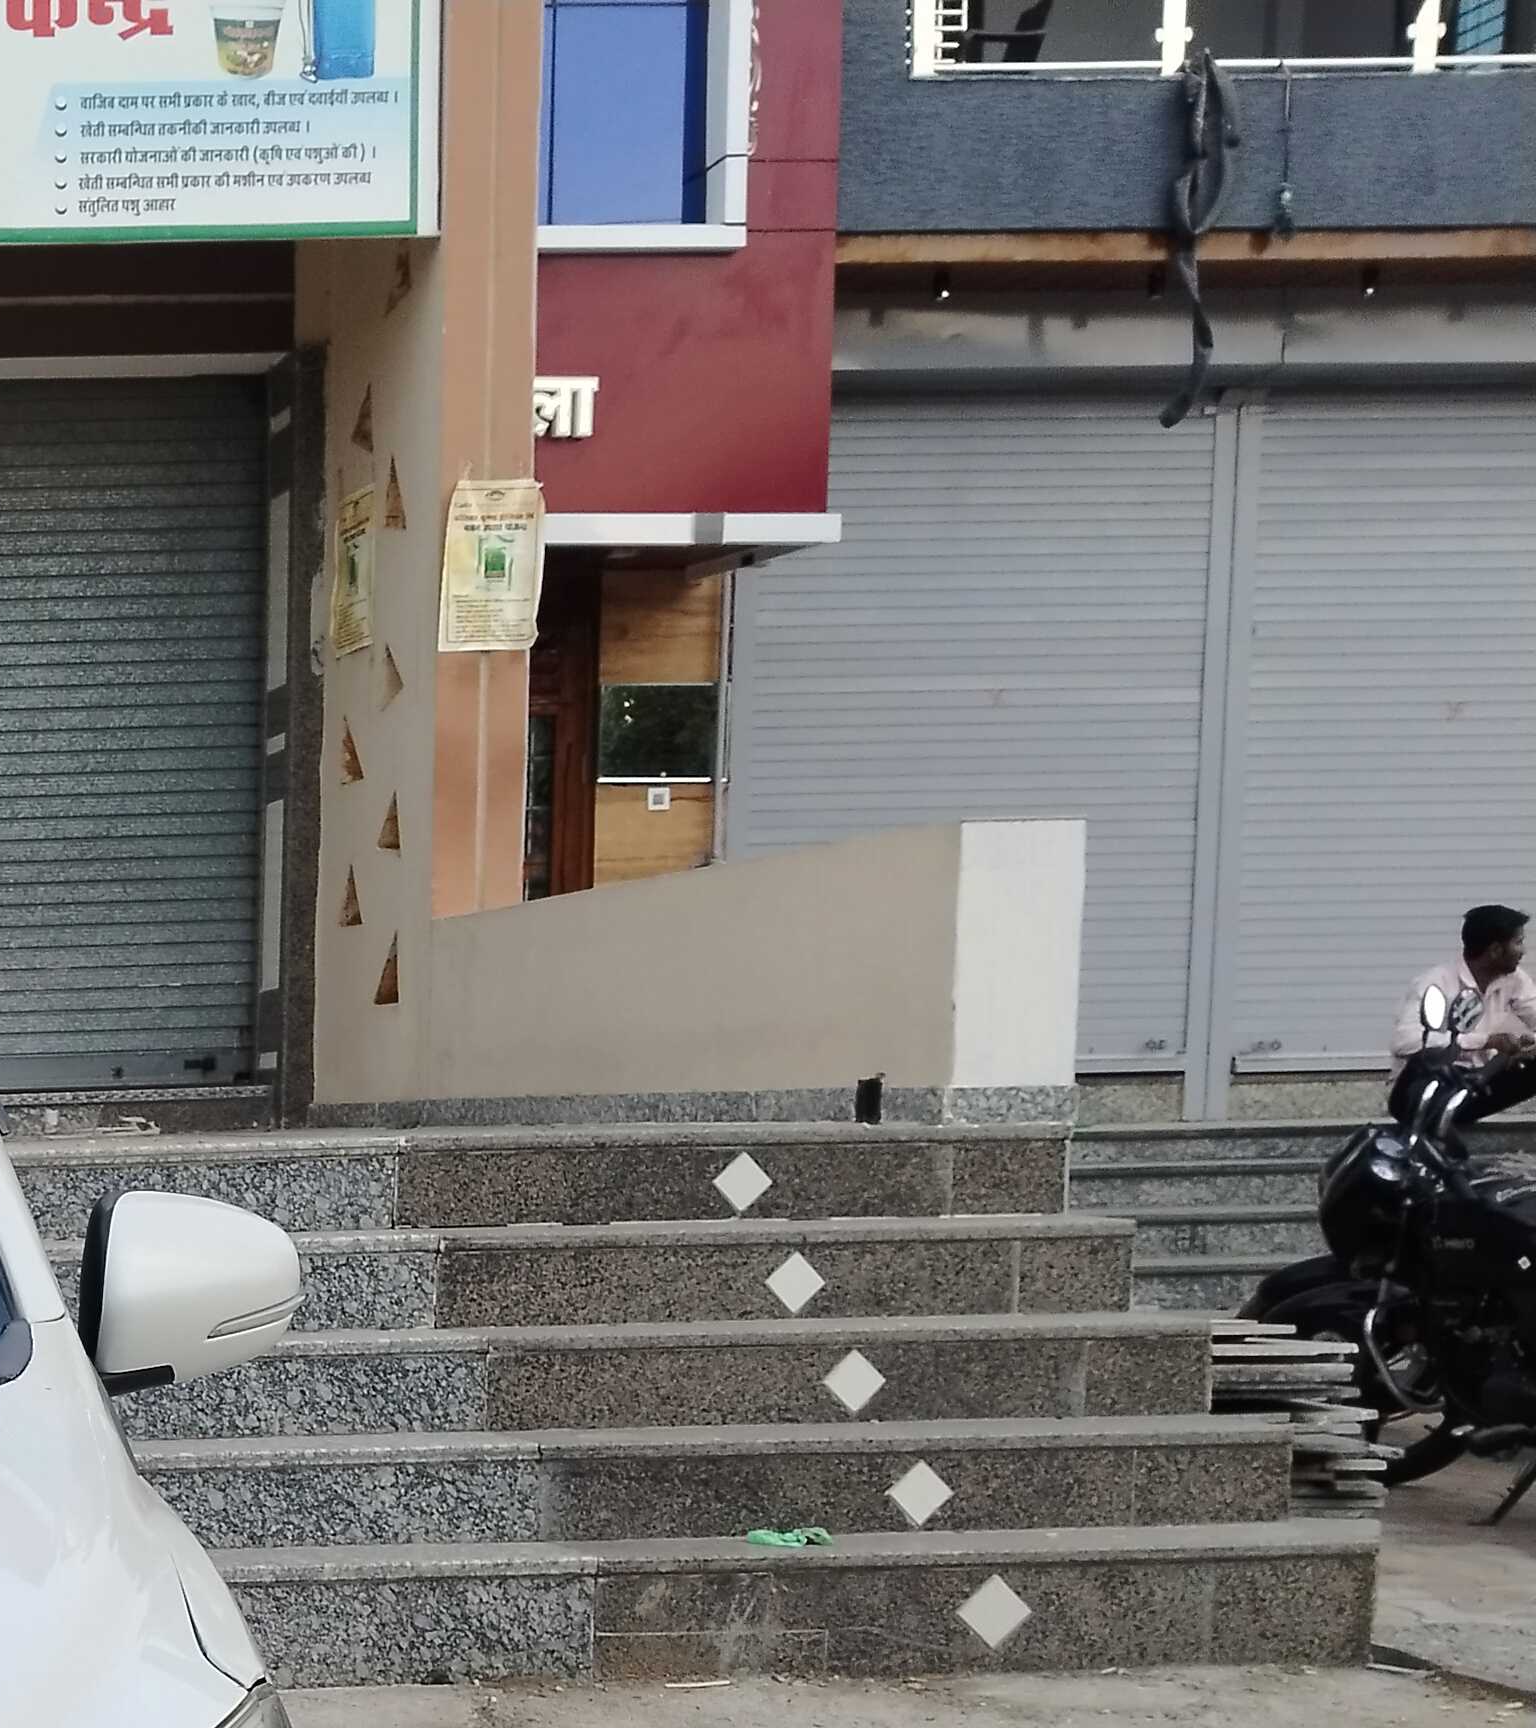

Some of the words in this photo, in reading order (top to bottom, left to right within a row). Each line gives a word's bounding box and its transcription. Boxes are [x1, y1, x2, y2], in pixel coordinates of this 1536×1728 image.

[118, 96, 139, 109] दाम
[142, 95, 156, 109] पर
[159, 91, 181, 109] सभी
[183, 94, 215, 109] प्रकार
[217, 91, 228, 107] के
[263, 90, 286, 107] बीज
[289, 90, 307, 106] एवं
[351, 90, 389, 104] उपलब्ध
[80, 120, 105, 137] खेती
[158, 118, 208, 136] तकनीकी
[209, 117, 260, 135] जानकारी
[262, 120, 301, 134] उपलब्ध
[80, 147, 122, 165] सरकारी
[125, 146, 180, 164] योजनाओं
[181, 146, 196, 162] की
[199, 145, 249, 162] जानकारी
[285, 146, 303, 160] एवं
[78, 173, 103, 190] खेती
[156, 172, 178, 189] सभी
[181, 174, 211, 189] प्रकार
[214, 171, 230, 187] की
[286, 172, 331, 186] उपकरण
[333, 171, 371, 185] उपलब्ध
[78, 196, 119, 218] संतुलित
[121, 199, 141, 216] पशु
[143, 198, 176, 212] आहार
